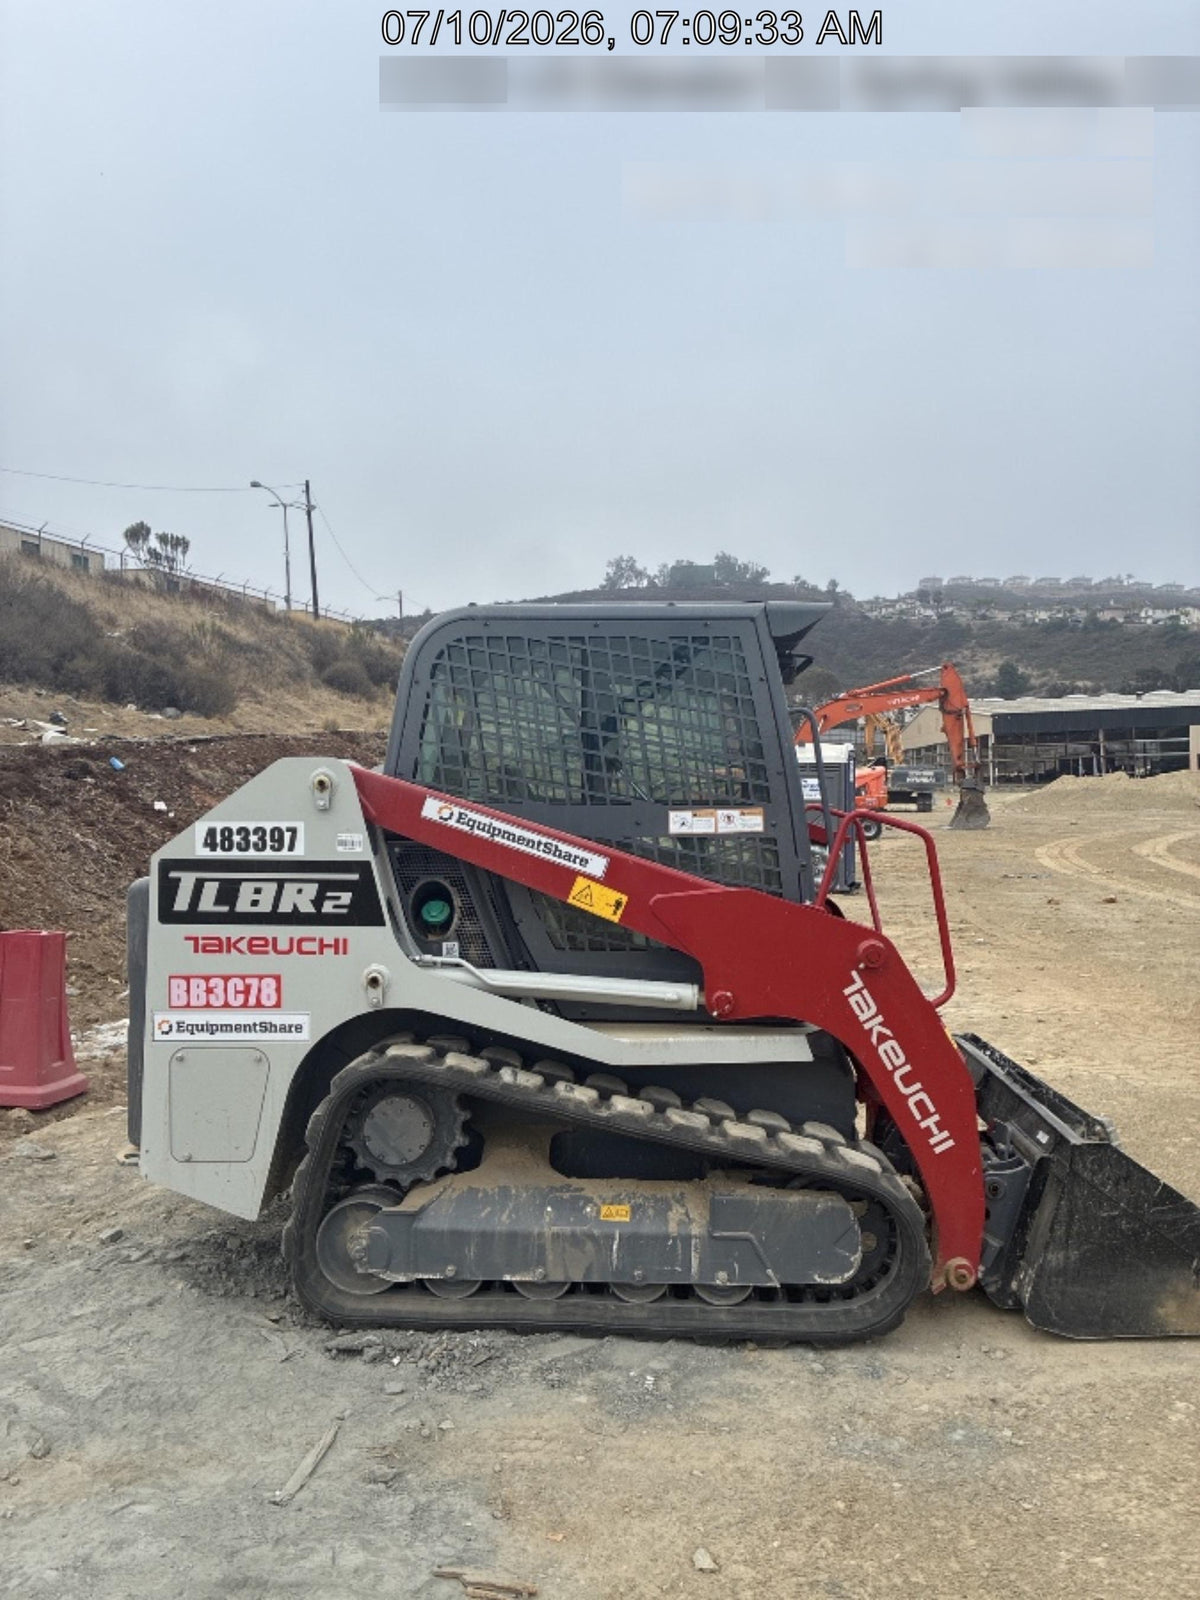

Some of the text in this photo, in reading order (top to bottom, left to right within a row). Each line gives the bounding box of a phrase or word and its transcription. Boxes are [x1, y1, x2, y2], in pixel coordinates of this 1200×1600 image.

[203, 826, 298, 852] 483397
[455, 811, 589, 868] EquipmentShare
[170, 977, 278, 1008] BB3C78
[176, 1021, 303, 1035] EquipmentShare
